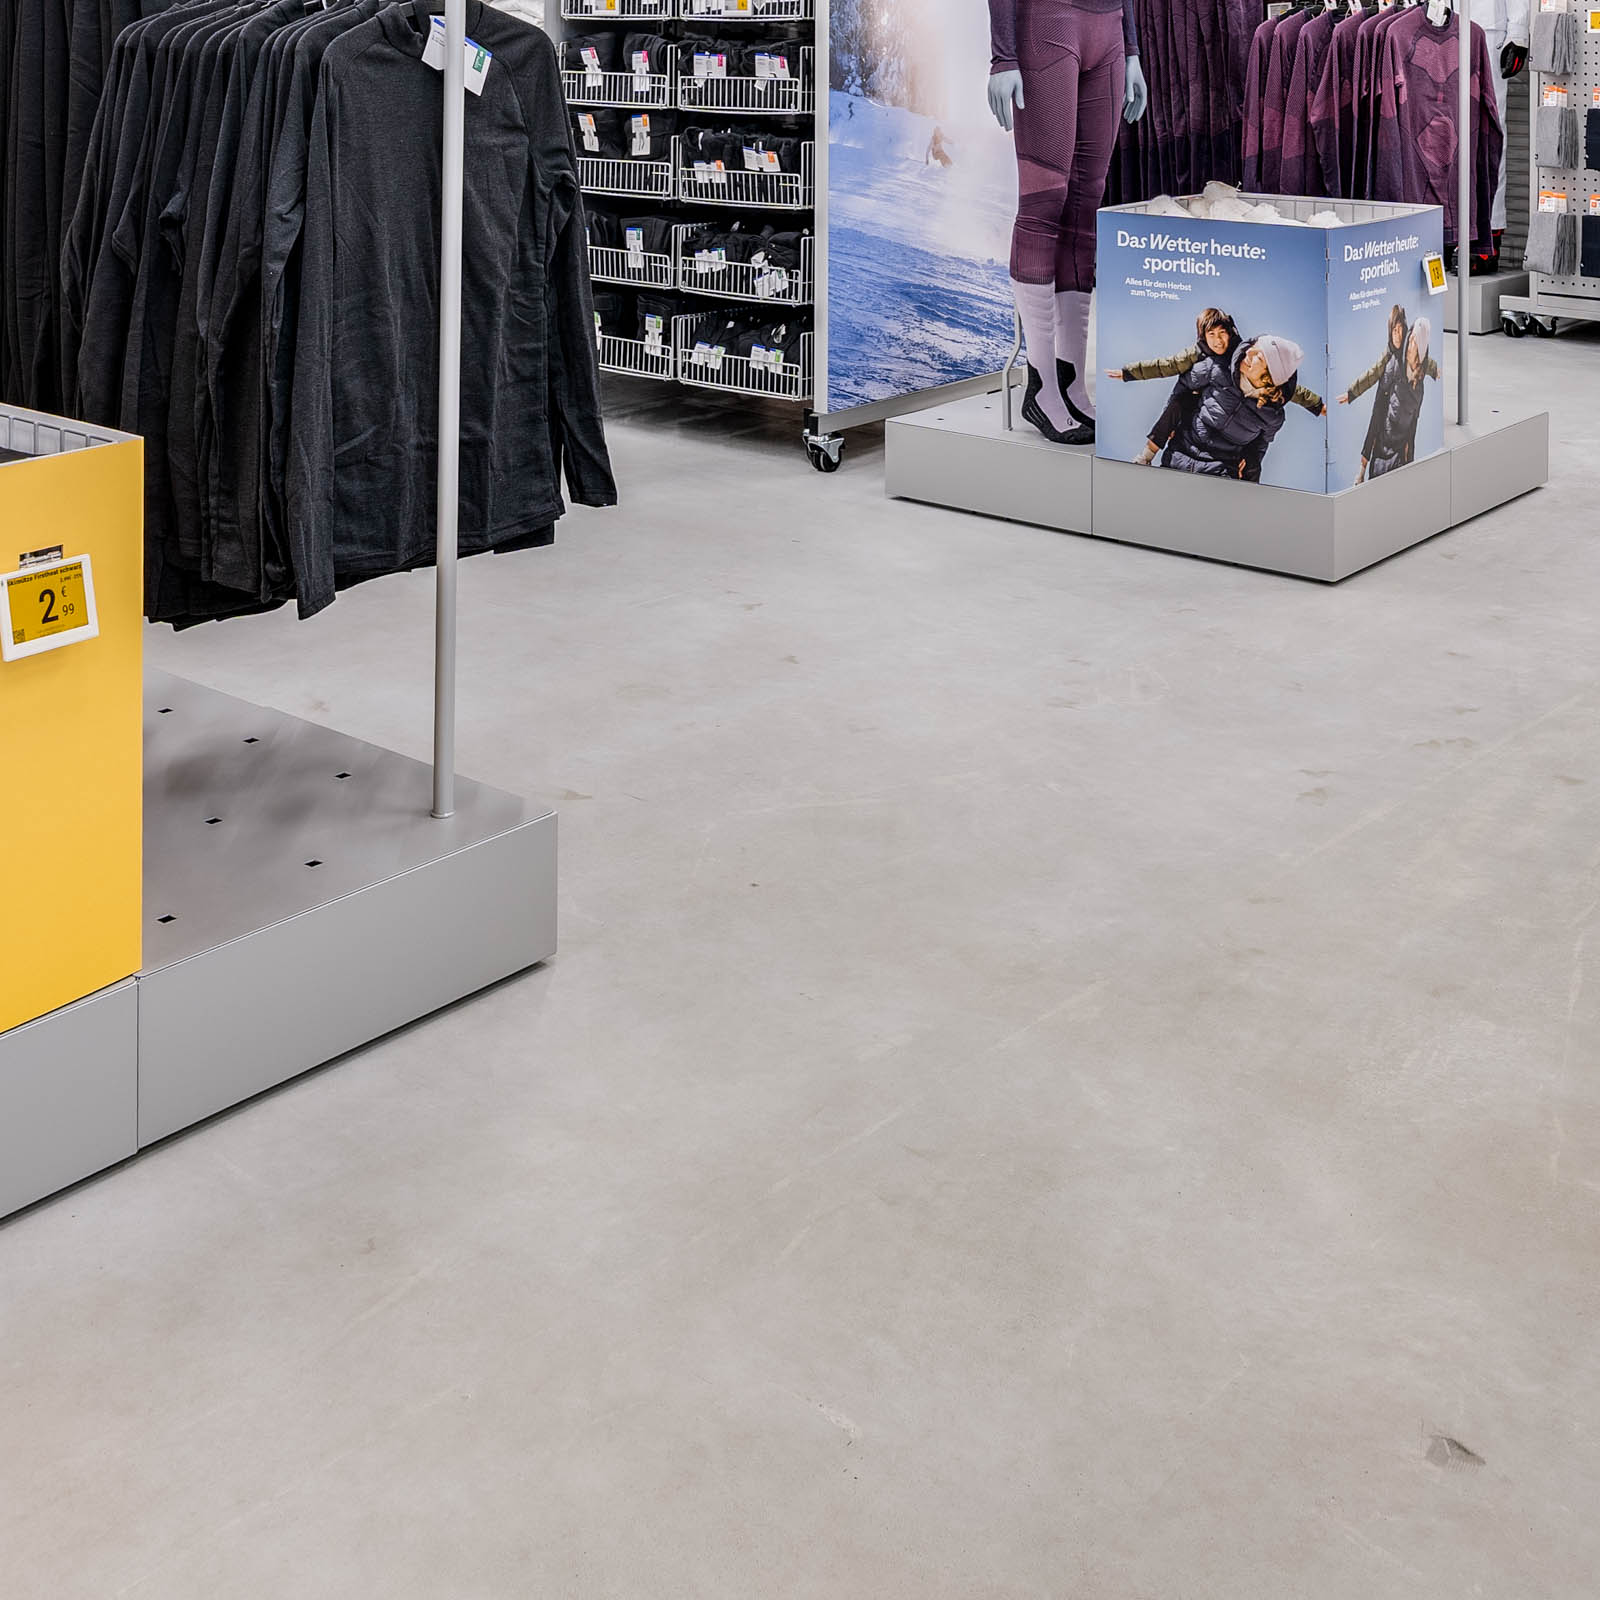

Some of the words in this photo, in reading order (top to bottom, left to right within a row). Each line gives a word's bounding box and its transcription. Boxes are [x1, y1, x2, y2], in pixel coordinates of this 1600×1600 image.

[1117, 230, 1147, 249] Das
[1150, 233, 1209, 255] Wetter
[1210, 238, 1267, 261] heute:
[1343, 245, 1363, 262] Das
[1363, 240, 1396, 259] Wetter
[1395, 234, 1419, 252] heute:
[1142, 256, 1221, 277] sportlich.
[1359, 257, 1400, 284] sportlich.
[1125, 277, 1142, 286] Alles
[1143, 279, 1153, 287] für
[1154, 280, 1167, 288] den
[1168, 281, 1192, 291] Herbst
[1130, 289, 1146, 297] zum
[1146, 289, 1181, 300] Top-Preis.
[61, 586, 68, 597] €
[38, 588, 59, 625] 2
[62, 603, 75, 617] 99
